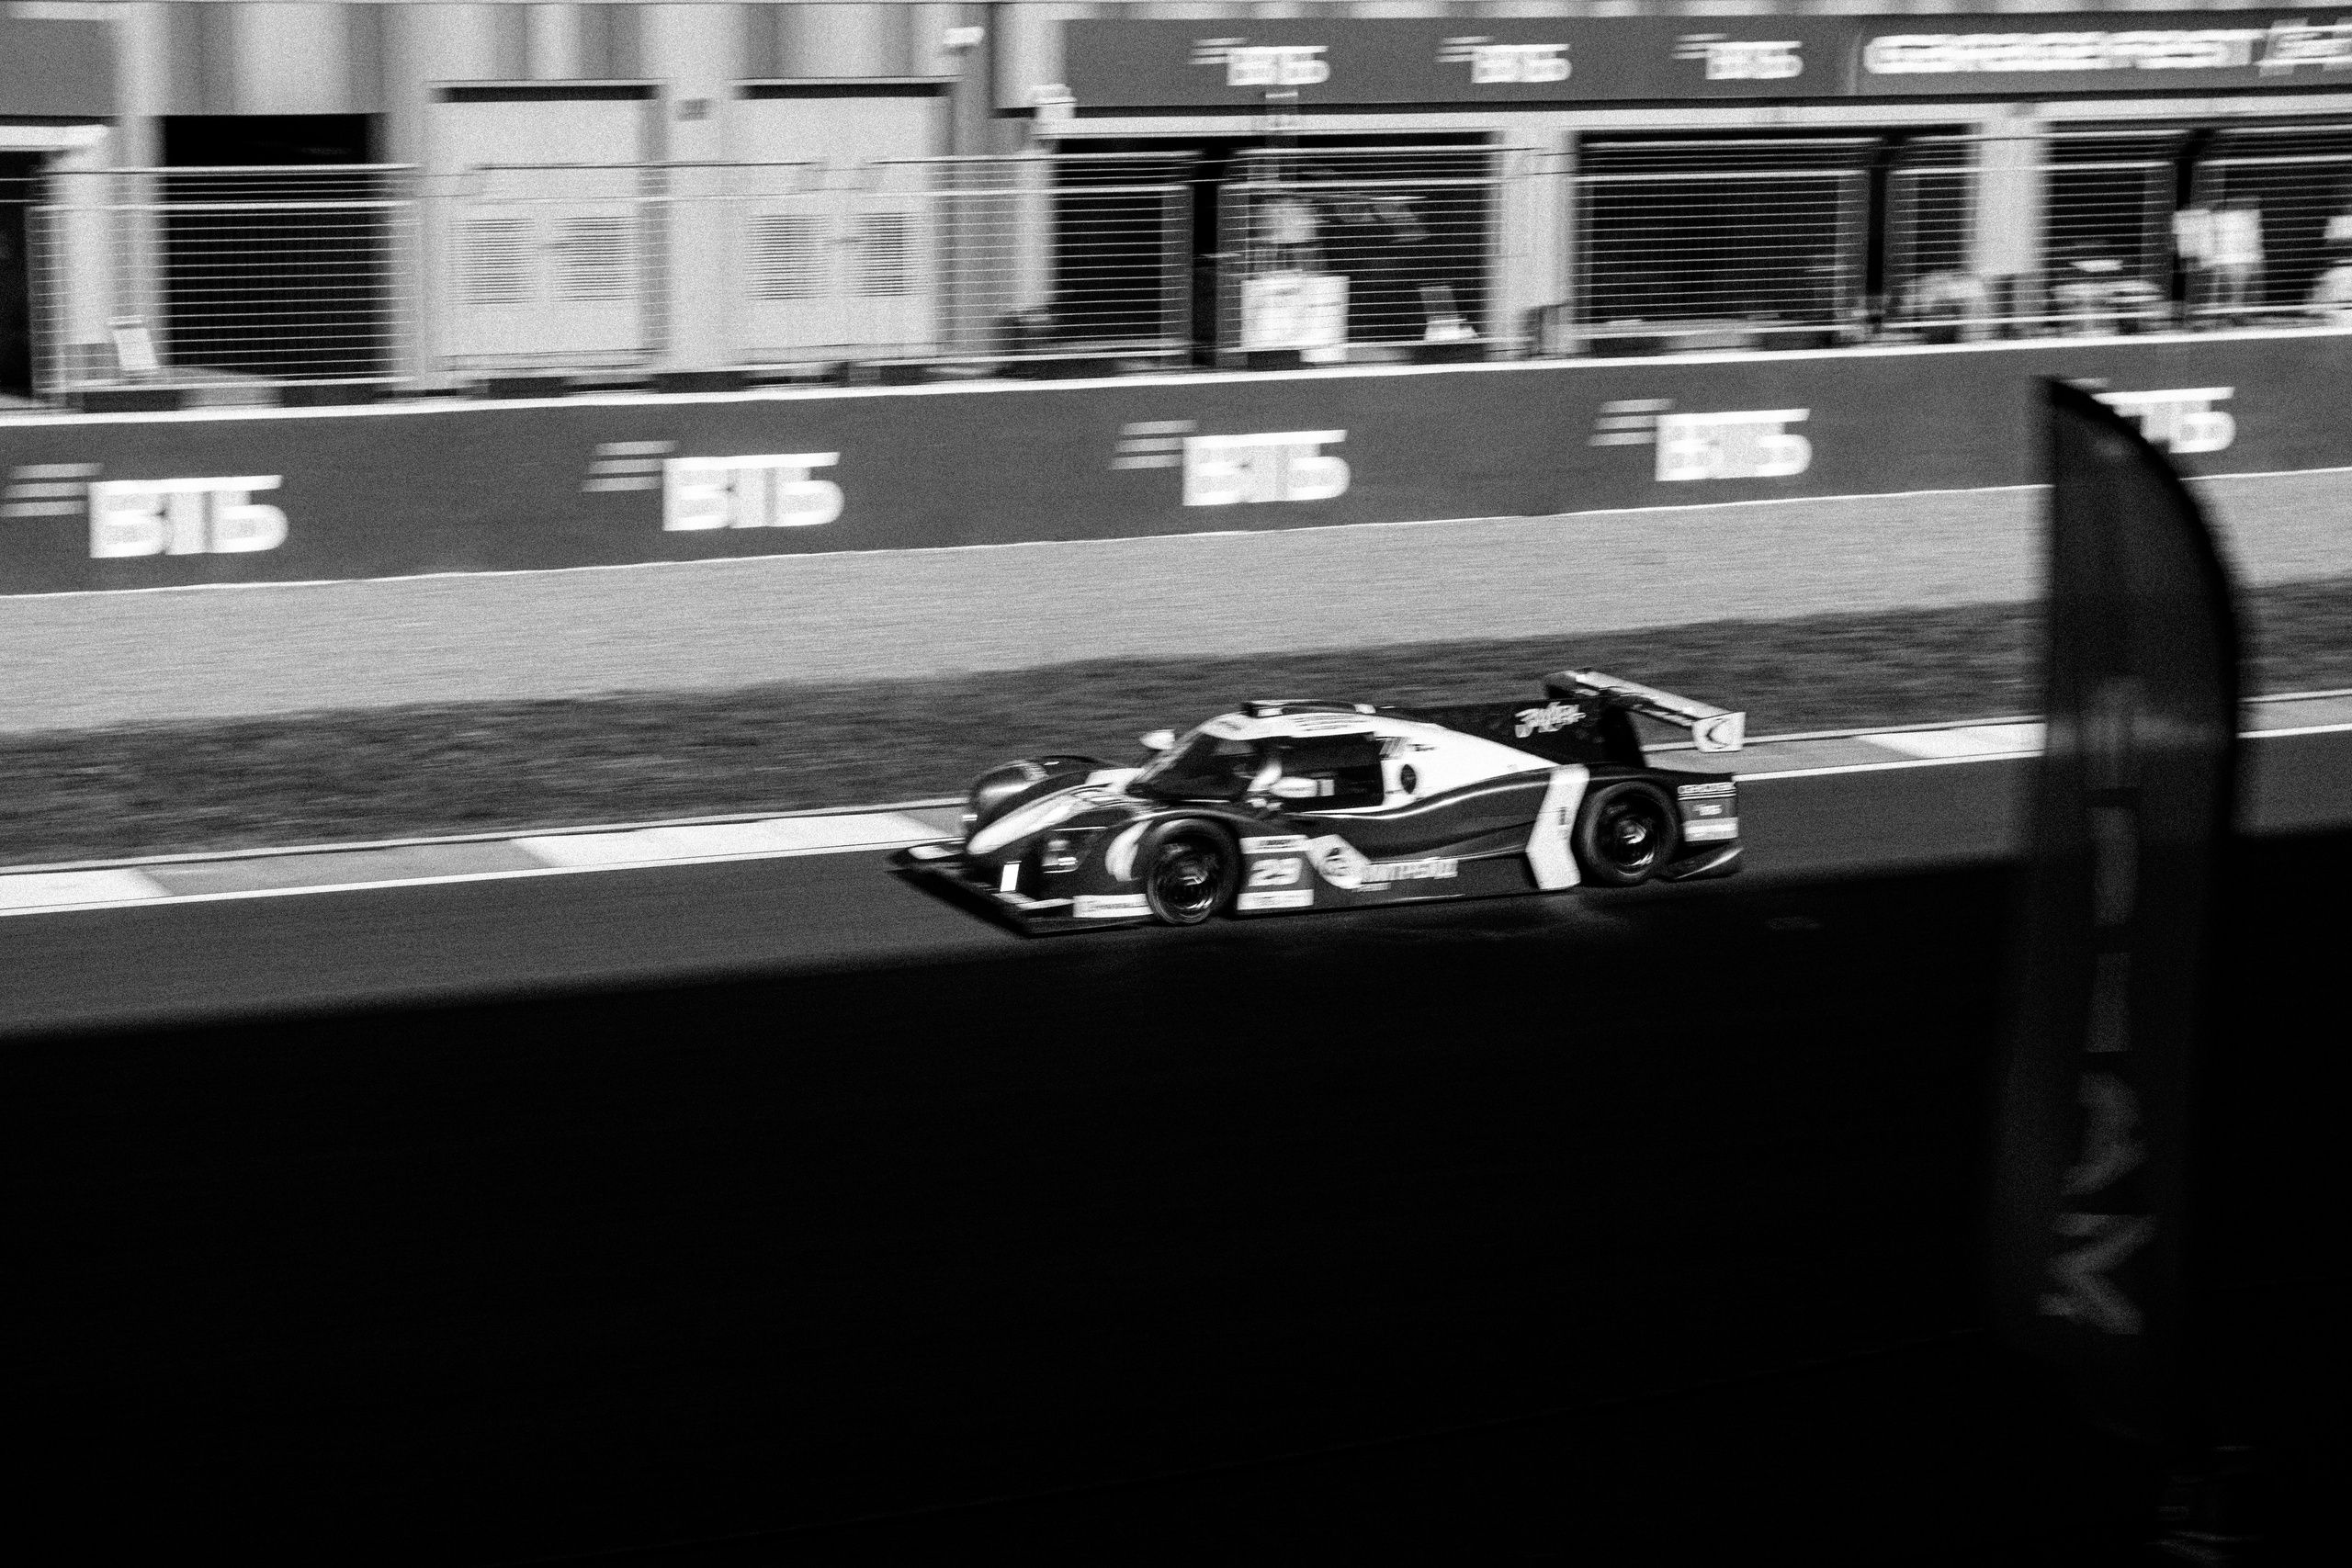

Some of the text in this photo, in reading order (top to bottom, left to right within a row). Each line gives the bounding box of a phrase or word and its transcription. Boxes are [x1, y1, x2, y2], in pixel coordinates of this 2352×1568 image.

[1182, 429, 1351, 506] ВТБ
[1656, 408, 1813, 481] ВТБ
[89, 474, 288, 558] ВТБ
[662, 452, 845, 531] ВТБ
